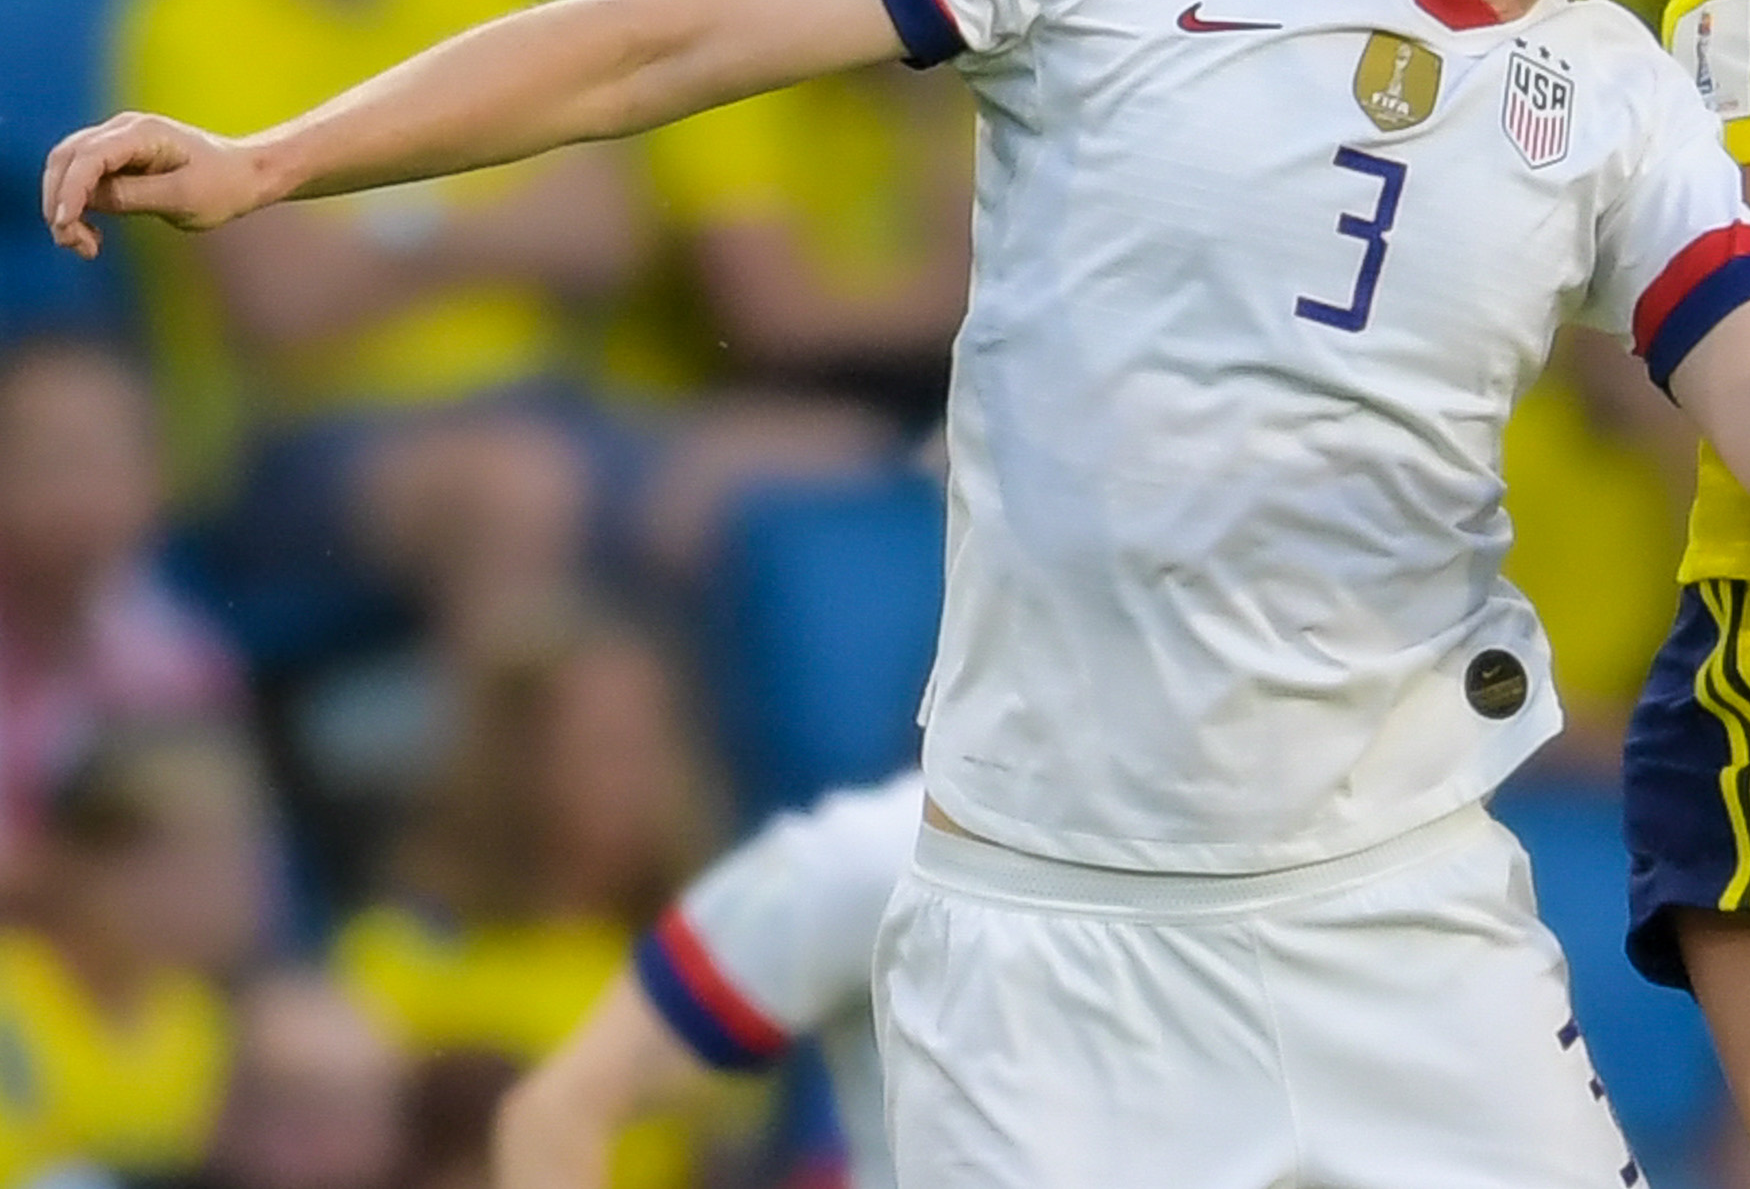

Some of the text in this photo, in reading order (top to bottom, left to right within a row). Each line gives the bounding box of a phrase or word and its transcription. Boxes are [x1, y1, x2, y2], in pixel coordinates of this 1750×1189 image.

[1371, 91, 1410, 117] FIFA
[1514, 61, 1567, 111] USA
[1294, 145, 1407, 332] 3
